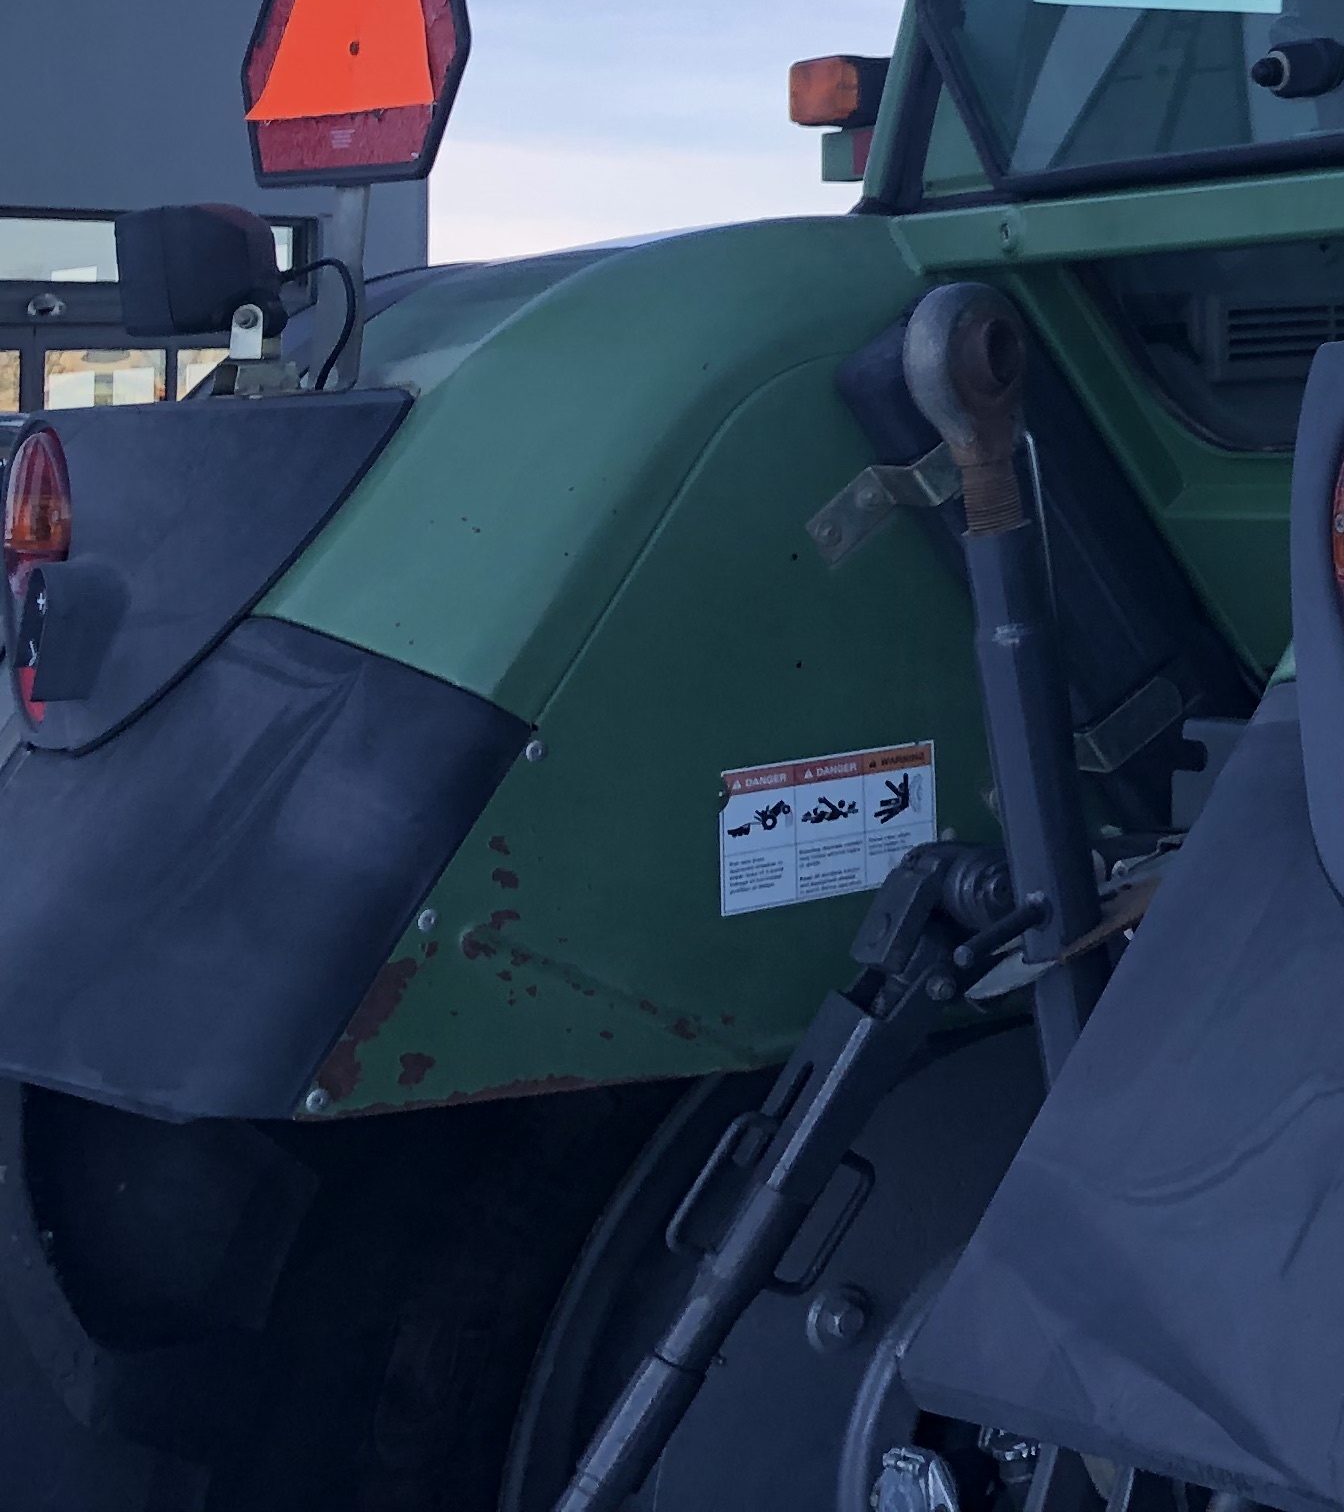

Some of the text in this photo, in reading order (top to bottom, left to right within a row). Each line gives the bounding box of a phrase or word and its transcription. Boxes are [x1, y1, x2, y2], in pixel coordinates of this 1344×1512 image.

[881, 751, 925, 766] WARNING
[816, 762, 858, 777] DANGER
[745, 773, 788, 788] DANGER
